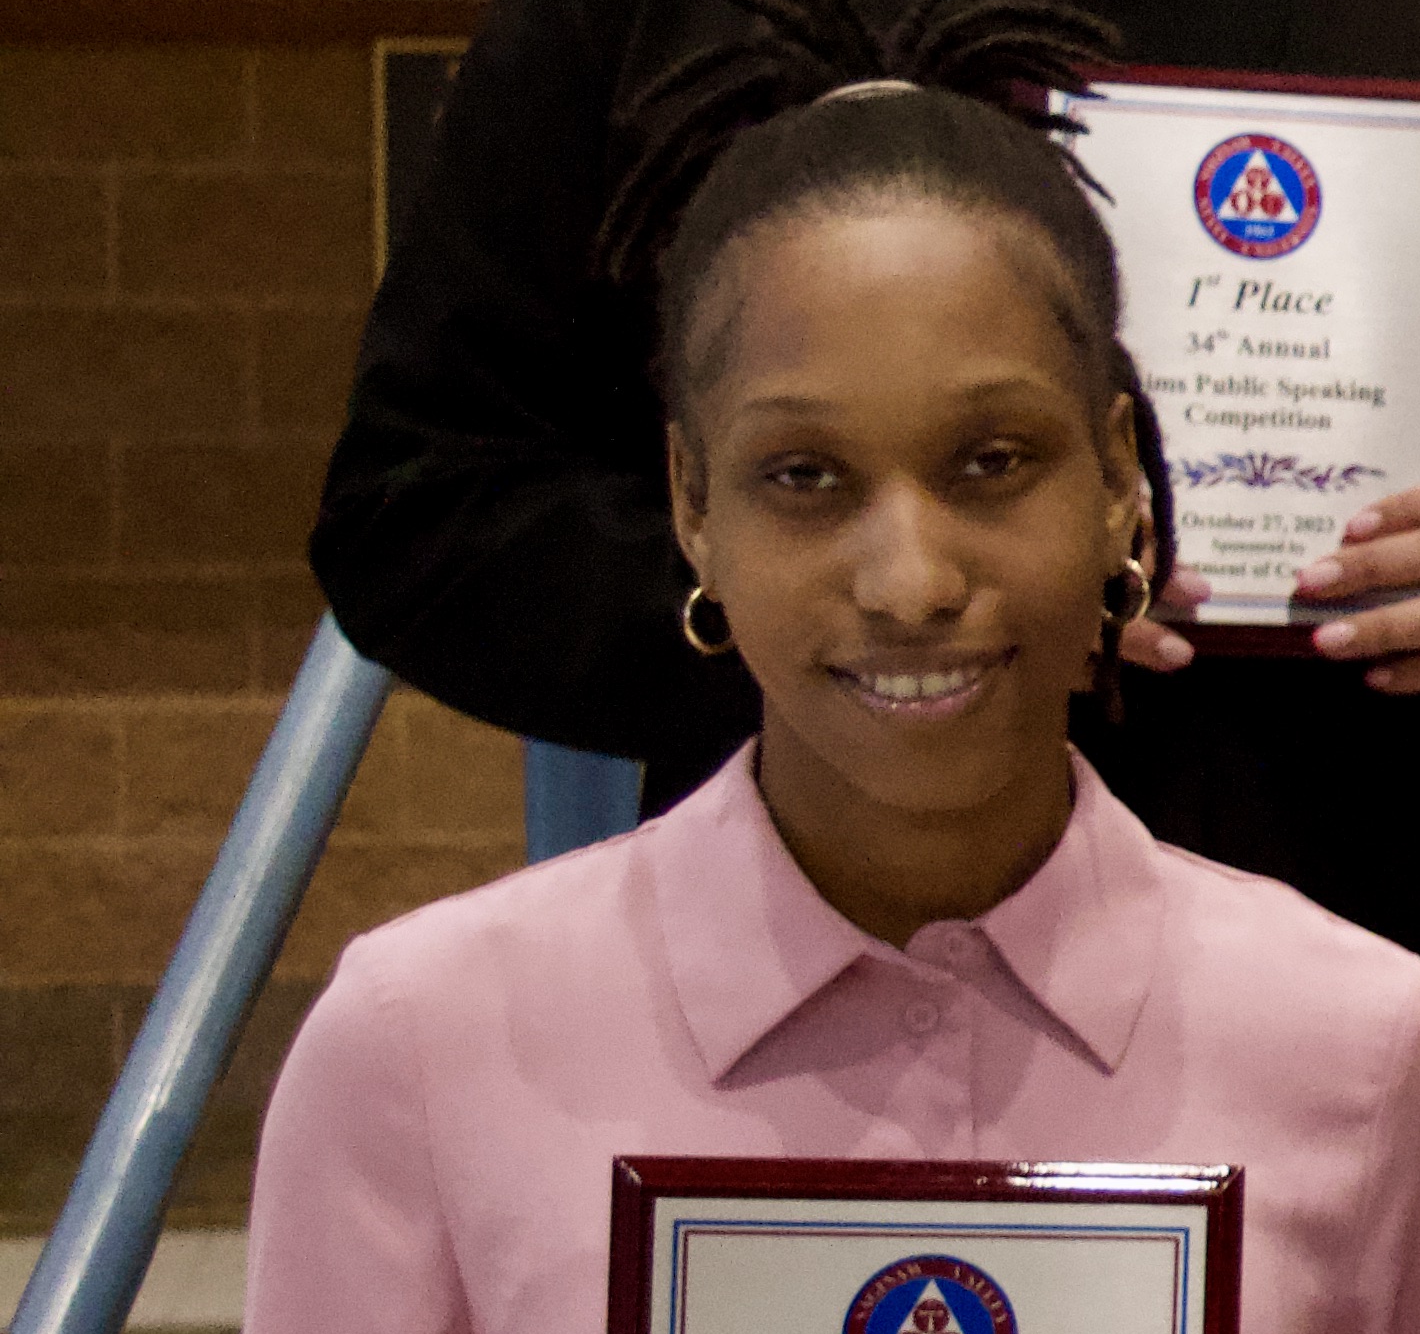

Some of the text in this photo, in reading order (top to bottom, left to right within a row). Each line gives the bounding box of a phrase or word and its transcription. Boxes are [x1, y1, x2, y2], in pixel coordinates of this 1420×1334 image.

[1187, 273, 1334, 315] 1st Place
[1237, 336, 1332, 360] Annual
[1143, 373, 1387, 408] ims Public Speaking
[1185, 403, 1332, 432] Competition
[1181, 512, 1254, 530] October
